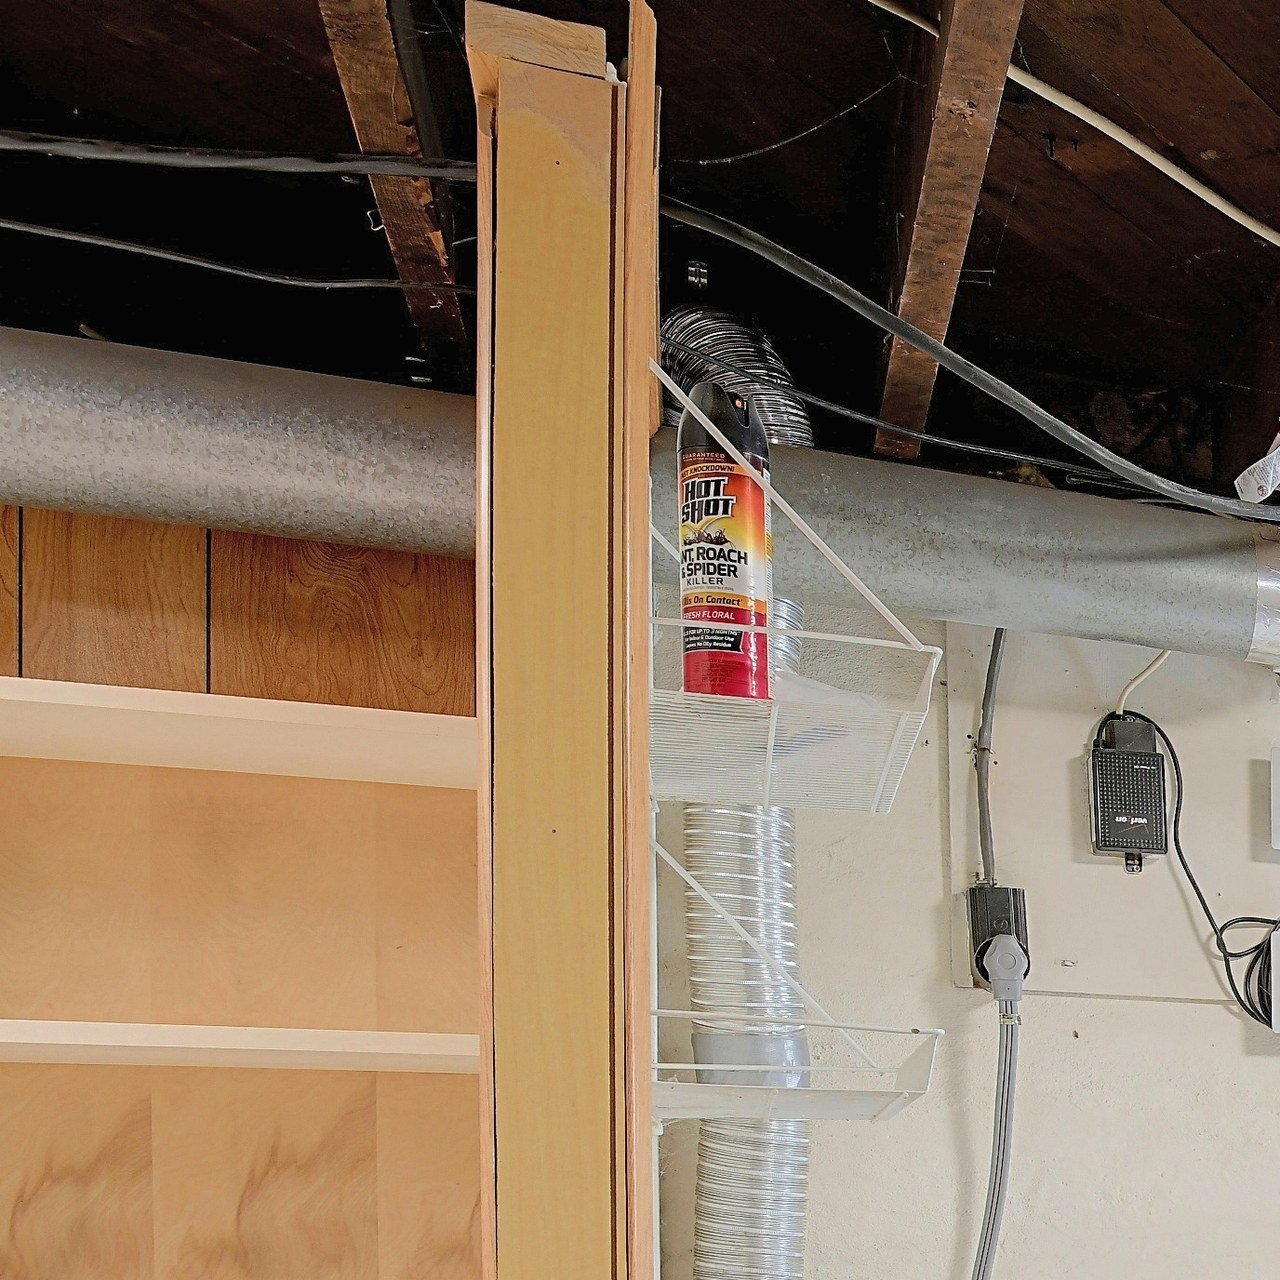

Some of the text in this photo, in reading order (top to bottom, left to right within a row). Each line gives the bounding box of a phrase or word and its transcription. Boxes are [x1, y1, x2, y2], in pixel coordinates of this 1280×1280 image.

[689, 464, 735, 476] KNOCKDOWN!
[683, 477, 728, 502] HOT
[681, 496, 736, 525] SHOT
[681, 547, 748, 566] NT, ROACH
[686, 562, 739, 578] SPIDER
[686, 577, 724, 586] KILLER
[693, 595, 703, 604] On
[702, 610, 735, 620] FLORAL
[1116, 814, 1148, 825] verizon
